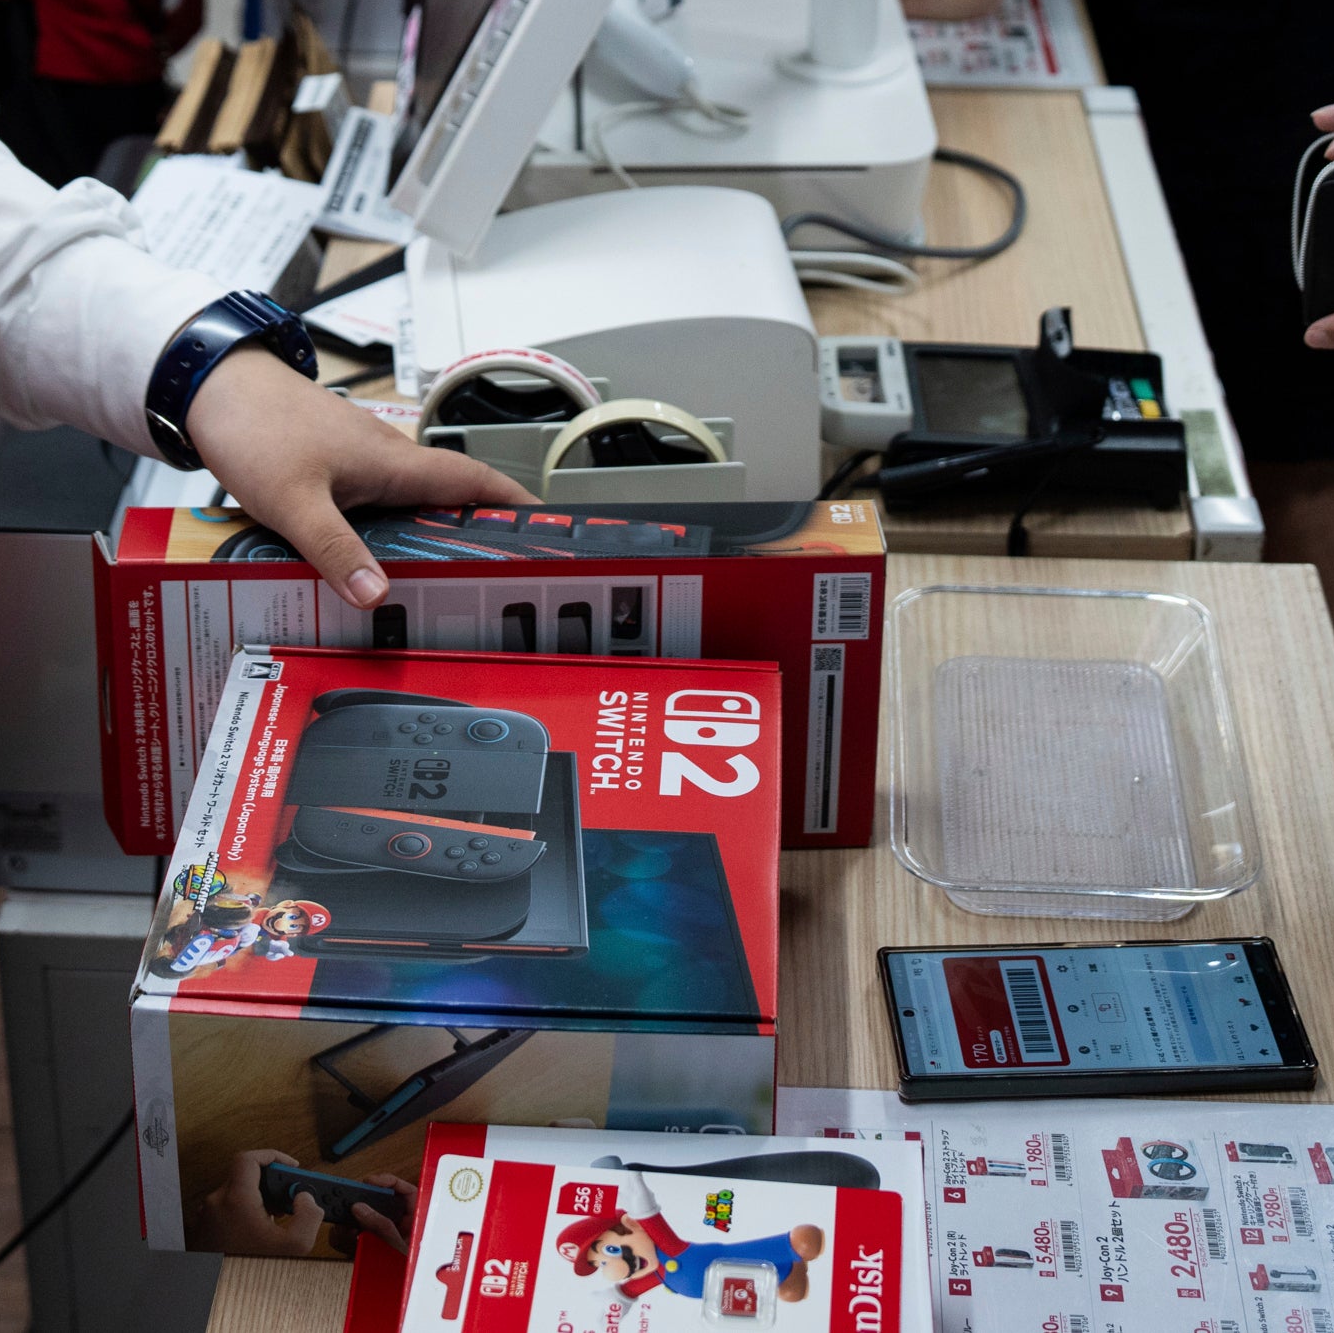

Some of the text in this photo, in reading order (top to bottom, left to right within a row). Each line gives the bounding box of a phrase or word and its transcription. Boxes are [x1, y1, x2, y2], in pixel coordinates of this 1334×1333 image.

[231, 691, 250, 723] Nintendo
[223, 723, 240, 753] Switch
[591, 690, 628, 790] SWITCH
[625, 692, 649, 791] NINTENDO
[137, 745, 148, 777] Switch
[659, 751, 760, 798] 2
[247, 771, 265, 804] System
[382, 759, 401, 797] SWITCH
[395, 760, 408, 797] NINTENDO
[408, 783, 447, 801] 2
[138, 779, 151, 827] Nintendo
[237, 803, 255, 835] (Japan
[227, 834, 247, 861] Only)
[190, 866, 205, 901] WORLD
[972, 1044, 989, 1063] 170
[1026, 1133, 1044, 1172] 1,980円
[943, 1163, 952, 1185] Joy-Con
[1237, 1181, 1246, 1199] Switch
[573, 1186, 592, 1213] 256
[703, 1193, 717, 1226] SUPER
[714, 1189, 734, 1233] MARIO
[1240, 1200, 1250, 1226] Nintendo
[1262, 1187, 1286, 1229] 2,980円
[947, 1230, 957, 1239] (R)
[1034, 1221, 1053, 1265] 5,480円
[1164, 1212, 1198, 1278] 2,480円
[1246, 1229, 1260, 1238] 12
[484, 1259, 512, 1276] 2
[947, 1247, 959, 1276] Joy-Con
[958, 1234, 969, 1276] ライトレッド
[1099, 1245, 1115, 1283] Joy-Con
[1115, 1246, 1129, 1282] ハンドル
[515, 1261, 529, 1298] SWITCH
